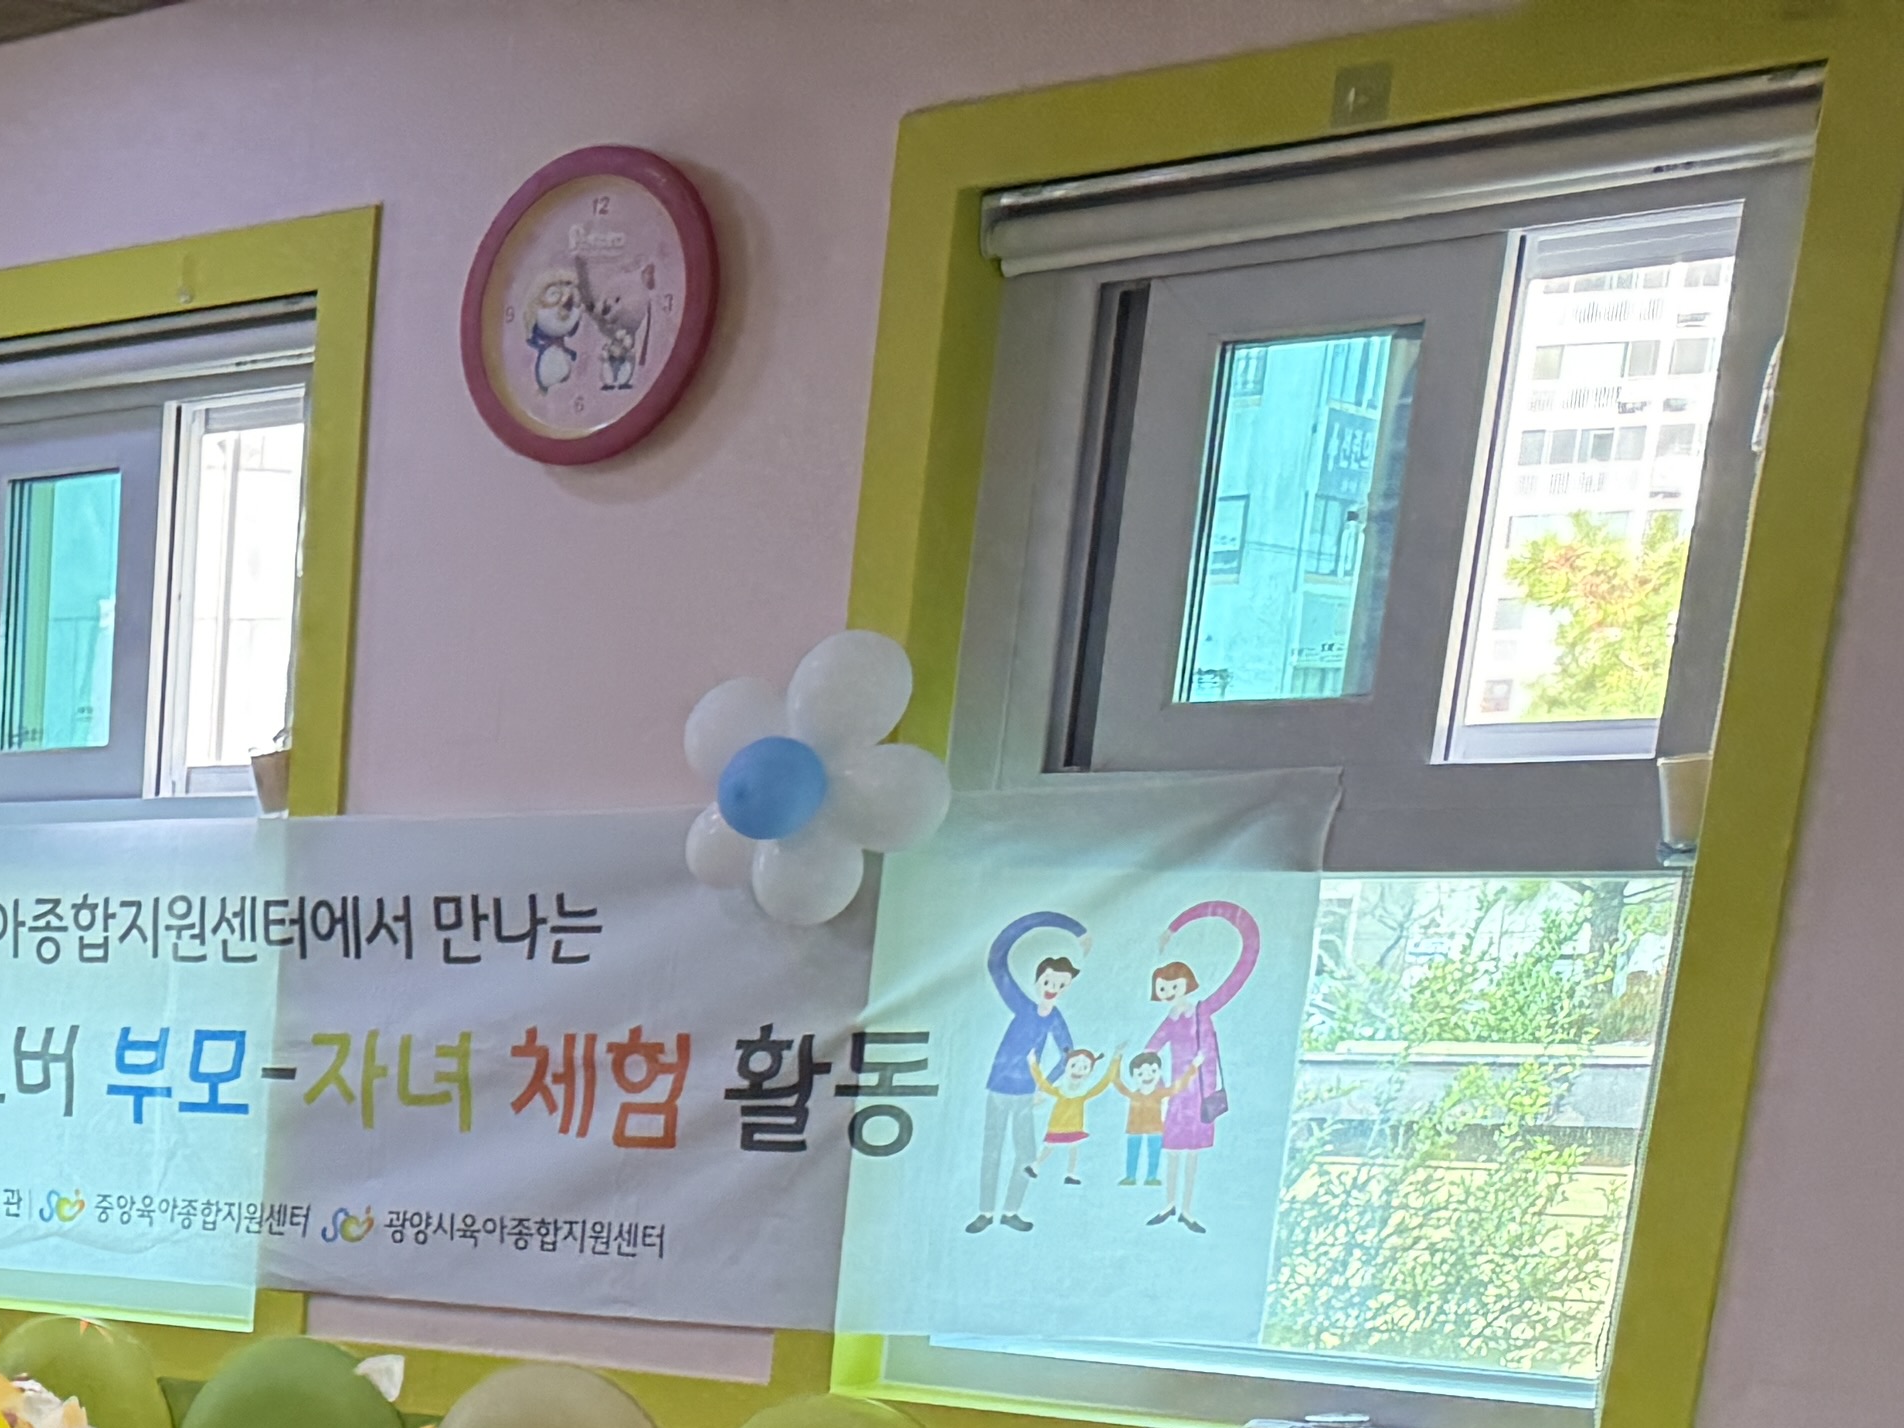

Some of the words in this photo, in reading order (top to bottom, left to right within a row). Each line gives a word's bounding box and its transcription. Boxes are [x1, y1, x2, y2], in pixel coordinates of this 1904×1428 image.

[592, 196, 611, 216] 12
[432, 893, 603, 966] 만나는
[510, 1025, 692, 1150] 체험
[723, 1023, 940, 1158] 활동
[93, 1193, 312, 1240] 중앙육아종합지원센터
[383, 1210, 667, 1259] 광양시육아종합지원센터
